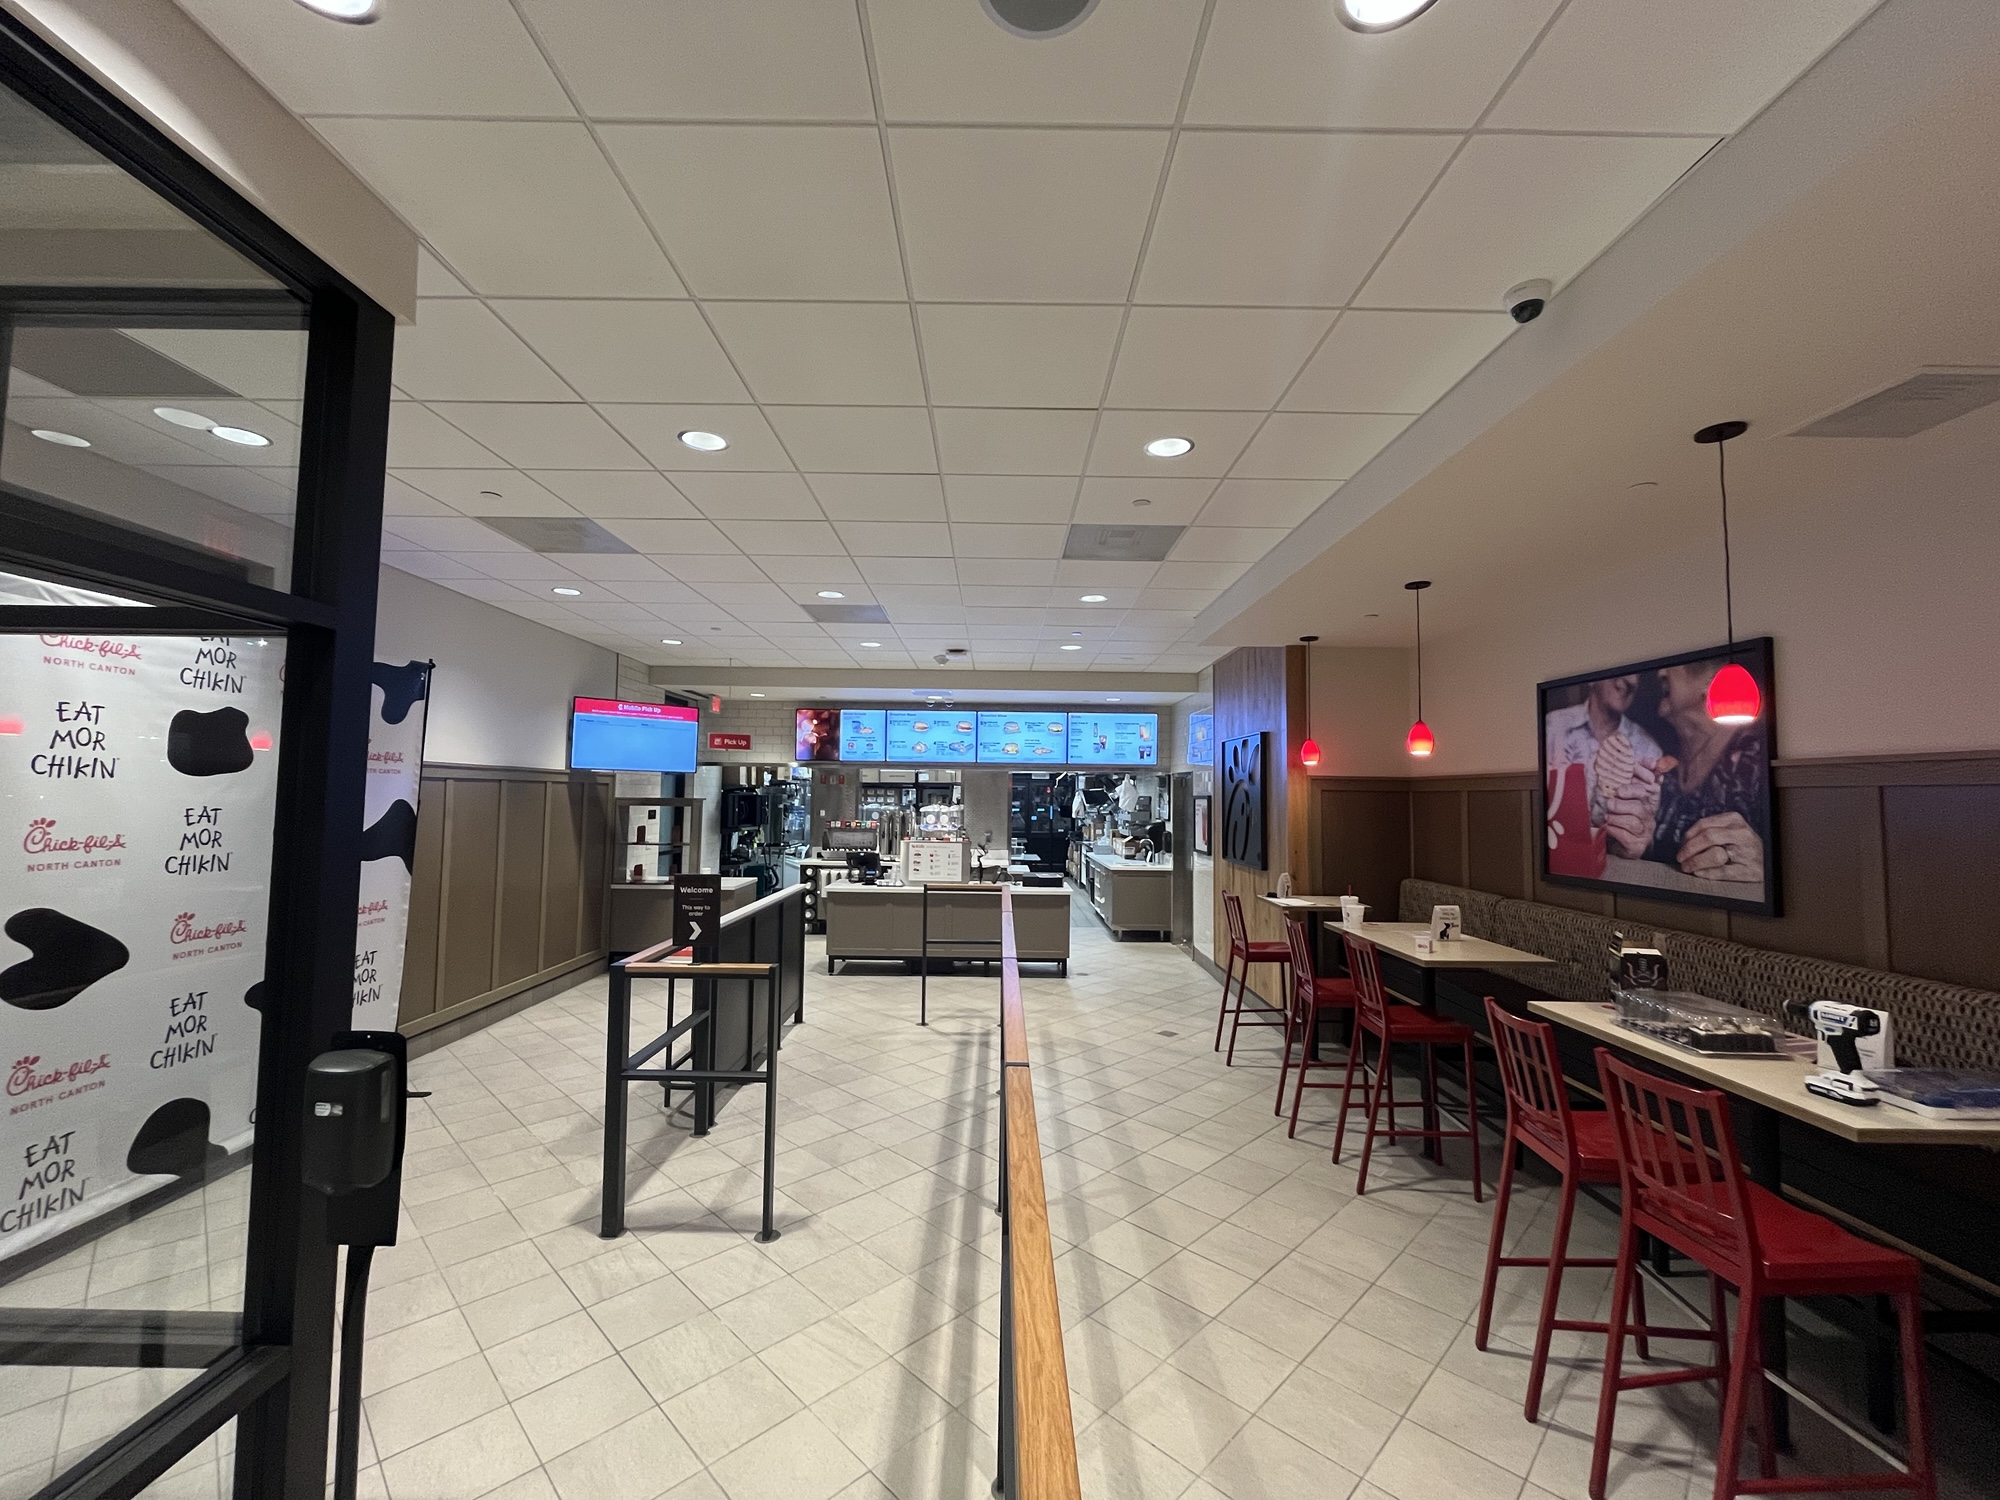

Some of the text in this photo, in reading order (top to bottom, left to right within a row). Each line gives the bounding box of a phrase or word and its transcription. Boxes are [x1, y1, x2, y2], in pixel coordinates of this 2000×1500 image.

[43, 656, 136, 676] NORTH CANTON
[195, 647, 237, 670] MOR
[179, 667, 244, 694] CHIKIN
[55, 701, 106, 725] EAT
[49, 727, 106, 751] MOR
[31, 754, 116, 779] CHIKIN
[184, 805, 223, 826] EAT
[23, 826, 127, 855] Chick-fil-A
[180, 828, 223, 851] MOR
[27, 858, 121, 872] NORTH CANTON
[164, 852, 230, 876] CHIKIN
[680, 886, 714, 894] Welcome
[170, 919, 247, 945] Chick-fil-A
[172, 941, 243, 961] NORTH CANTON
[169, 991, 209, 1017] EAT
[353, 984, 381, 1006] IKIN
[164, 1014, 207, 1044] MOR
[150, 1034, 215, 1069] CHIKIN
[6, 1054, 111, 1097] Chick-fil-A
[9, 1080, 106, 1116] NORTH CANTON
[24, 1130, 76, 1168] EAT
[18, 1159, 76, 1201] MOR
[0, 1179, 86, 1232] CHIKIN
